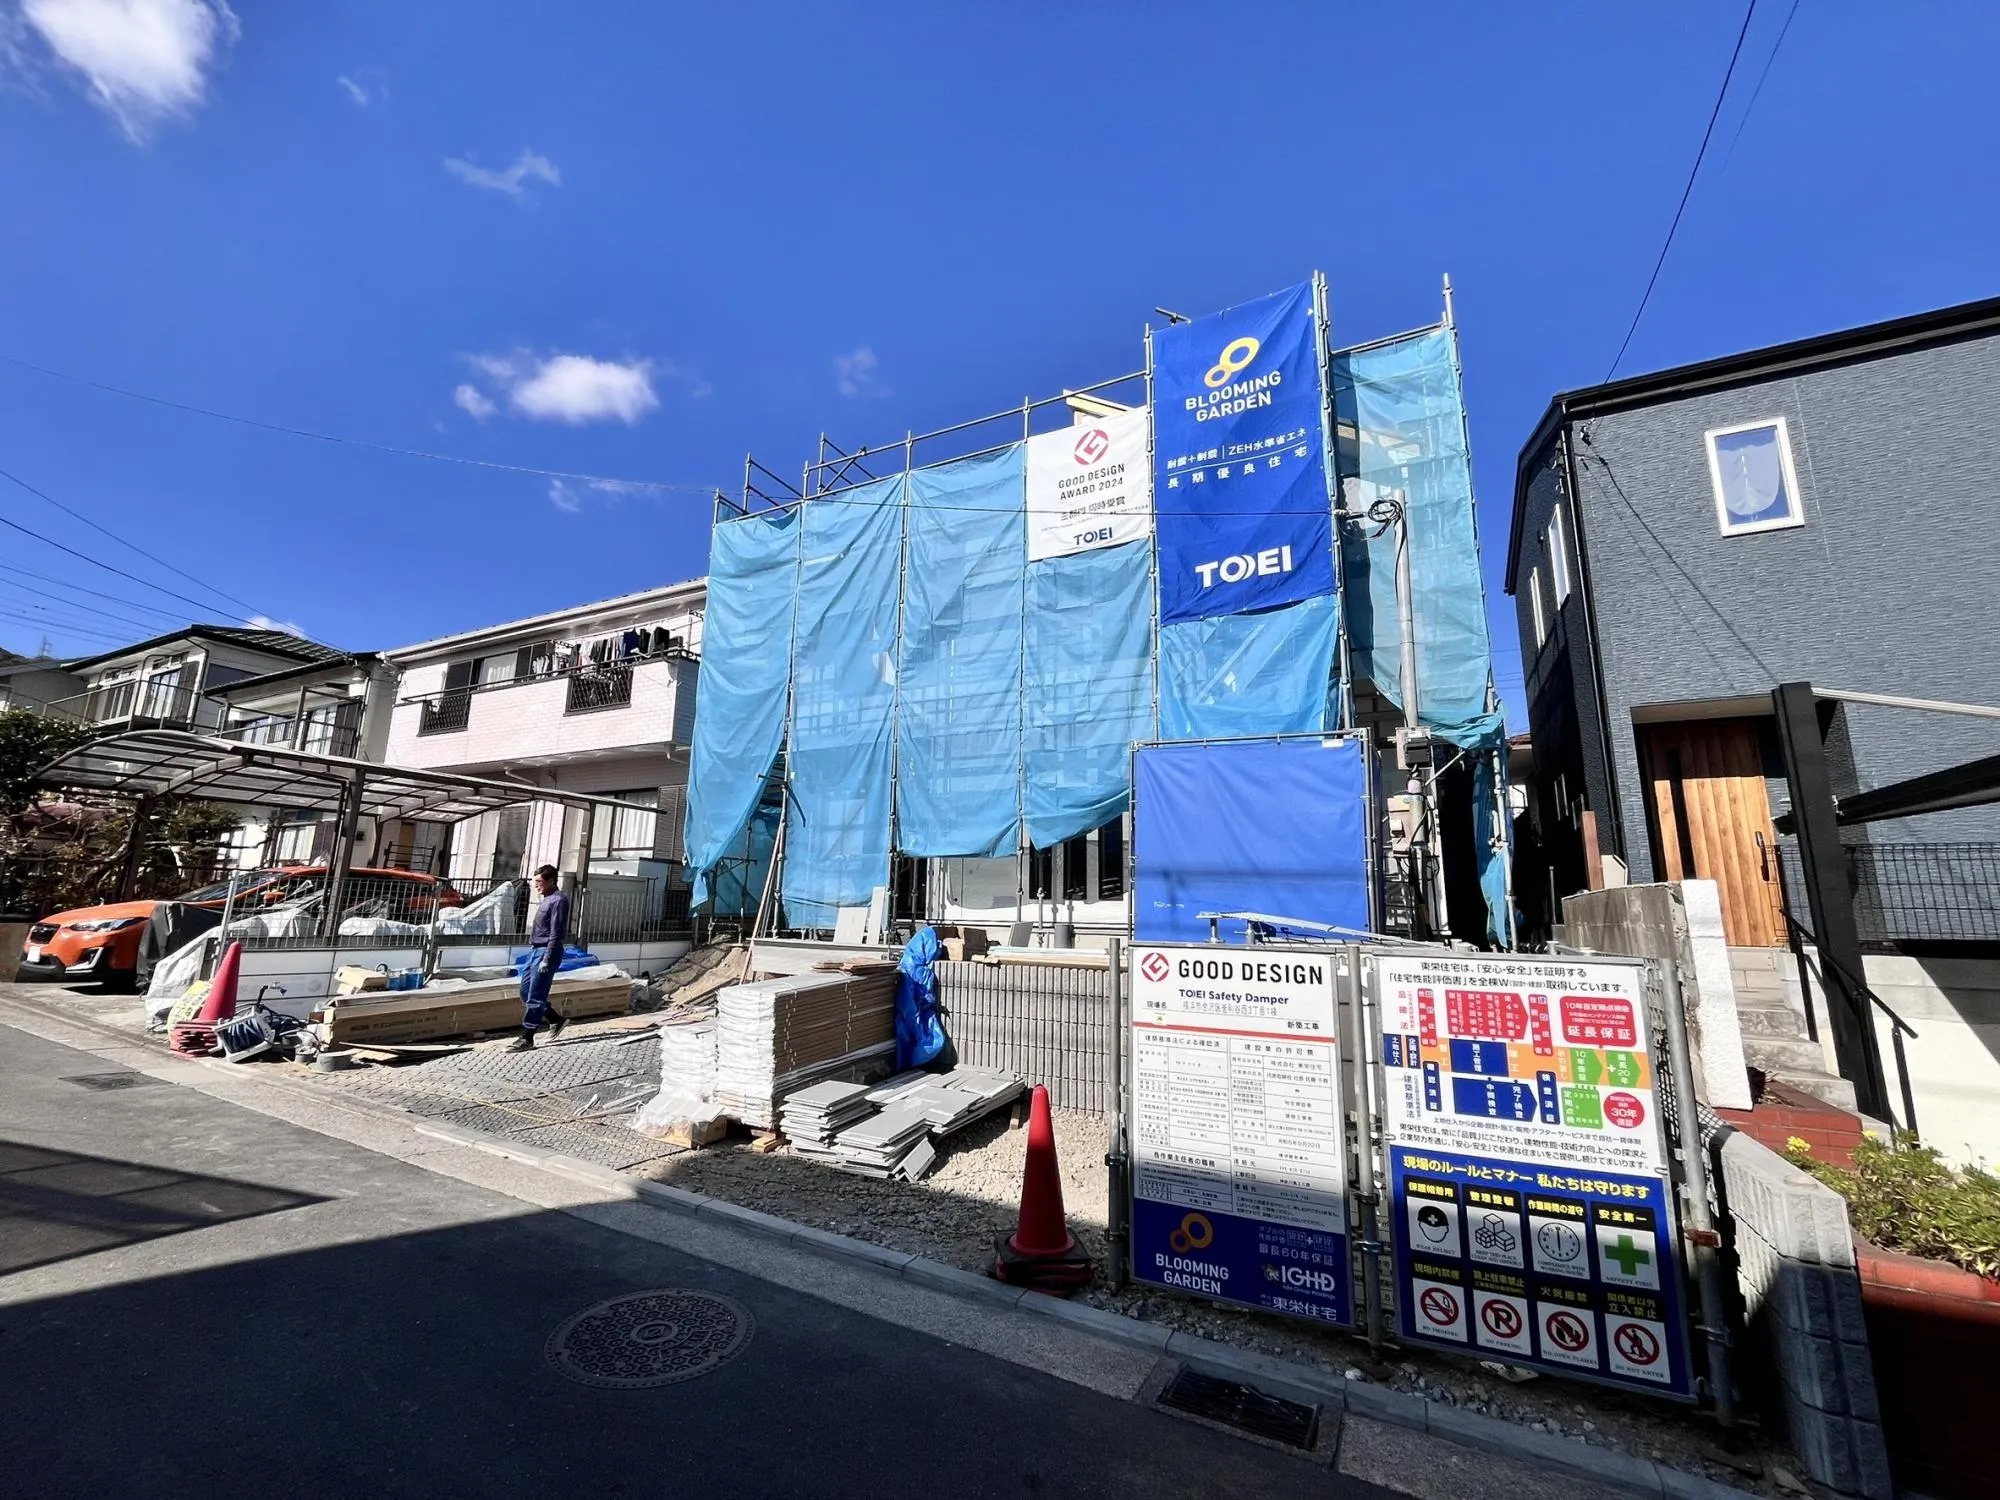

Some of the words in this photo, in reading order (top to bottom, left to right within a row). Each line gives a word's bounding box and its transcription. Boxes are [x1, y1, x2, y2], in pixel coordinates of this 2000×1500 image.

[1185, 371, 1282, 410] BLOOMING
[1195, 390, 1272, 422] GARDEN
[1058, 475, 1085, 489] GOOD
[1088, 463, 1125, 481] DESIGN
[1167, 446, 1308, 489] 長期優良住宅
[1060, 484, 1096, 500] AWARD
[1098, 477, 1123, 491] 2024
[1179, 959, 1234, 980] GOOD
[1242, 963, 1323, 985] DESIGN
[1209, 991, 1242, 1004] Safety
[1245, 993, 1289, 1006] Damper
[1287, 1021, 1320, 1031] 新築工事
[1567, 1025, 1632, 1041] 延長保証
[1245, 1043, 1314, 1056] 建設業の許可票
[1391, 1036, 1401, 1065] 土地仕入
[1403, 1074, 1415, 1119] 建築基準法
[1486, 1083, 1497, 1116] 中間検査
[1512, 1086, 1524, 1119] 完了検査
[1563, 1090, 1576, 1124] 定期点検
[1610, 1107, 1638, 1119] 30年
[1153, 1151, 1216, 1167] 各作業主任者の職務
[1403, 1155, 1533, 1183] 現場のルールとマナー
[1536, 1173, 1650, 1199] 私たちは守ります
[1598, 1209, 1648, 1223] 安全第一
[1155, 1253, 1229, 1280] BLOOMING
[1259, 1243, 1334, 1266] 最長60年保証
[1164, 1270, 1221, 1295] GARDEN
[1540, 1285, 1588, 1303] 火気厳禁
[1272, 1296, 1337, 1321] 東栄住宅
[1607, 1292, 1656, 1308] 関係者以外
[1609, 1303, 1657, 1319] 立入禁止
